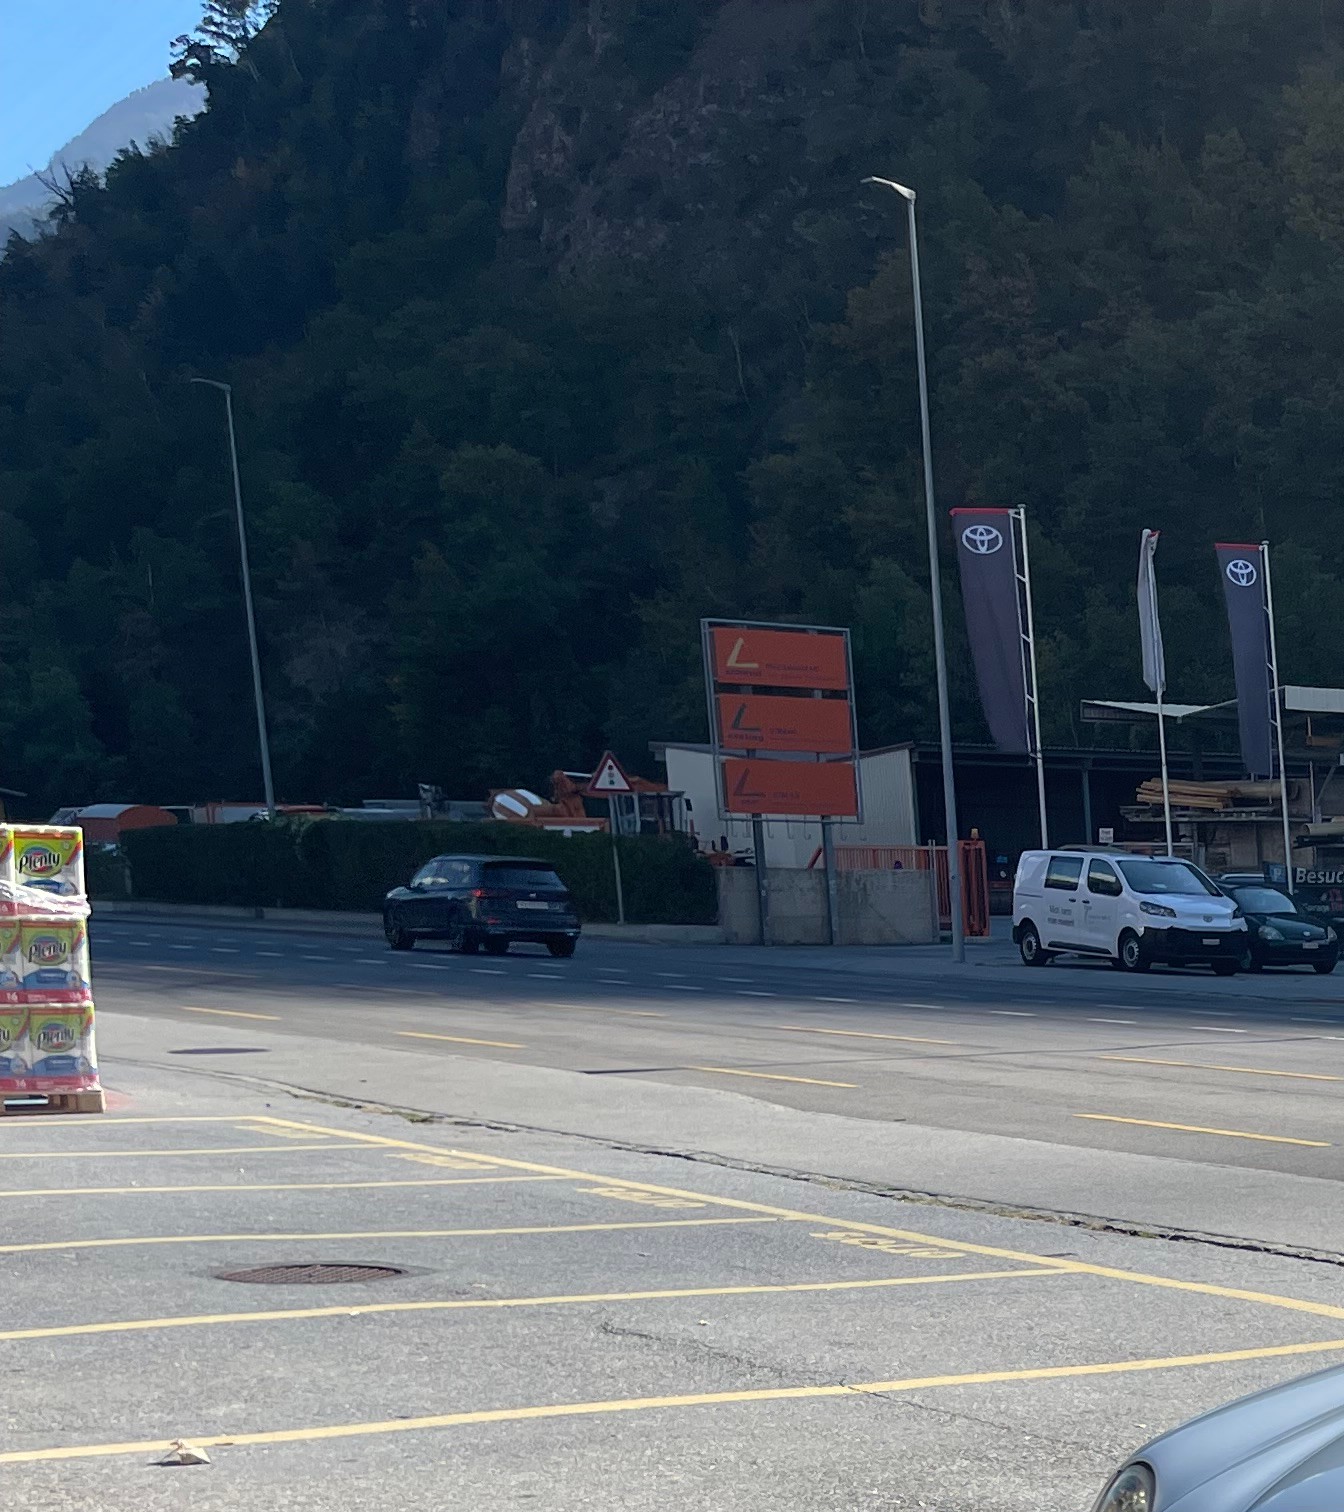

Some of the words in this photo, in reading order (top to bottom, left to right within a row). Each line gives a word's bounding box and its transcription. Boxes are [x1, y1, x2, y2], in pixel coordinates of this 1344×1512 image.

[19, 851, 60, 874] Plenty
[28, 941, 67, 964] Plenty
[37, 1027, 75, 1050] Plenty
